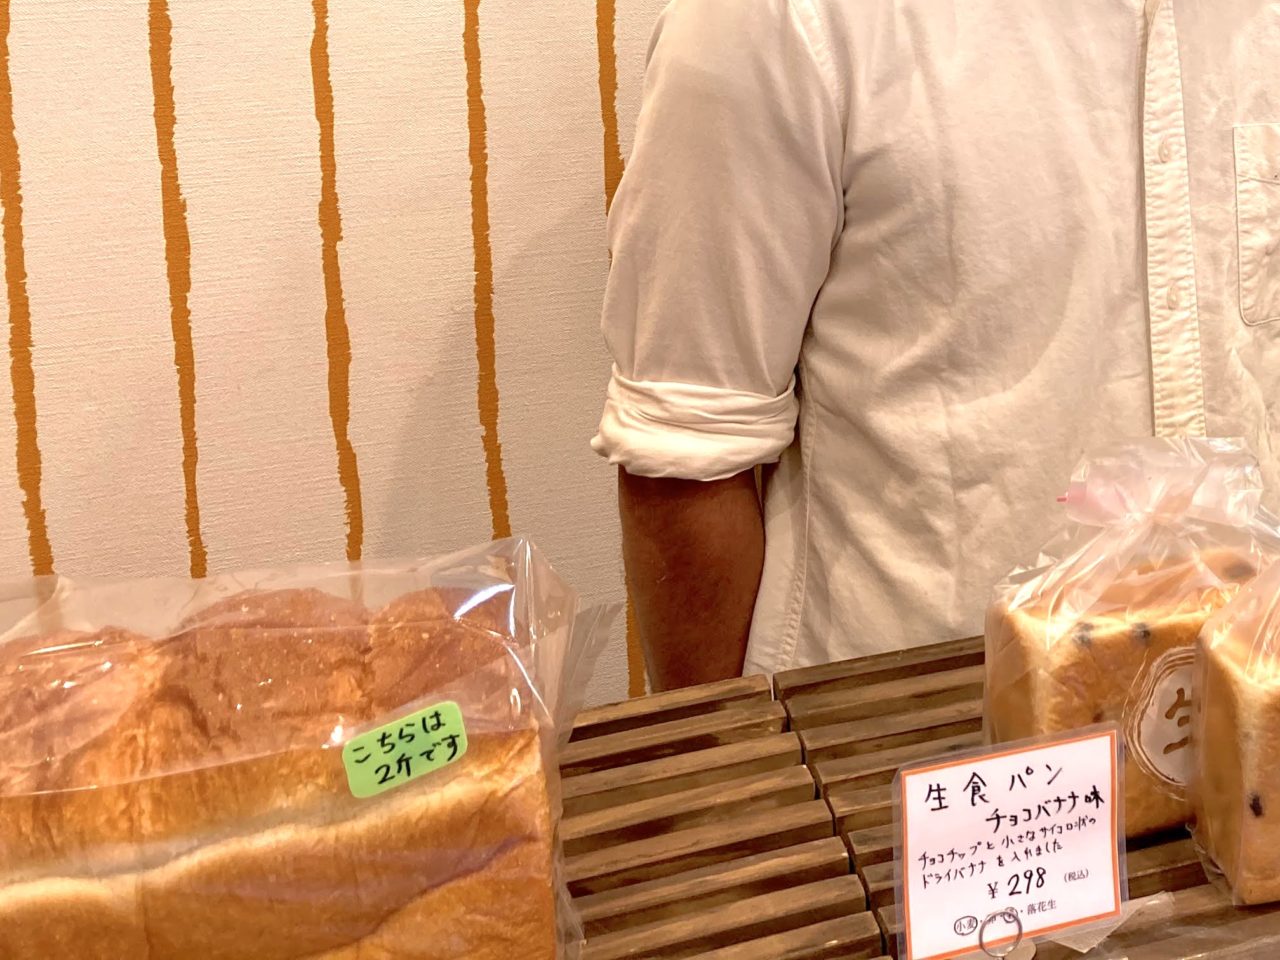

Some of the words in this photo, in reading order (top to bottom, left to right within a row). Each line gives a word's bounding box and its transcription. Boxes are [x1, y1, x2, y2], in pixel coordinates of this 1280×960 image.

[352, 710, 446, 763] こちらは
[374, 734, 460, 785] 2斤です
[924, 764, 1063, 812] 生食パン
[985, 785, 1105, 833] チョコバナナ味
